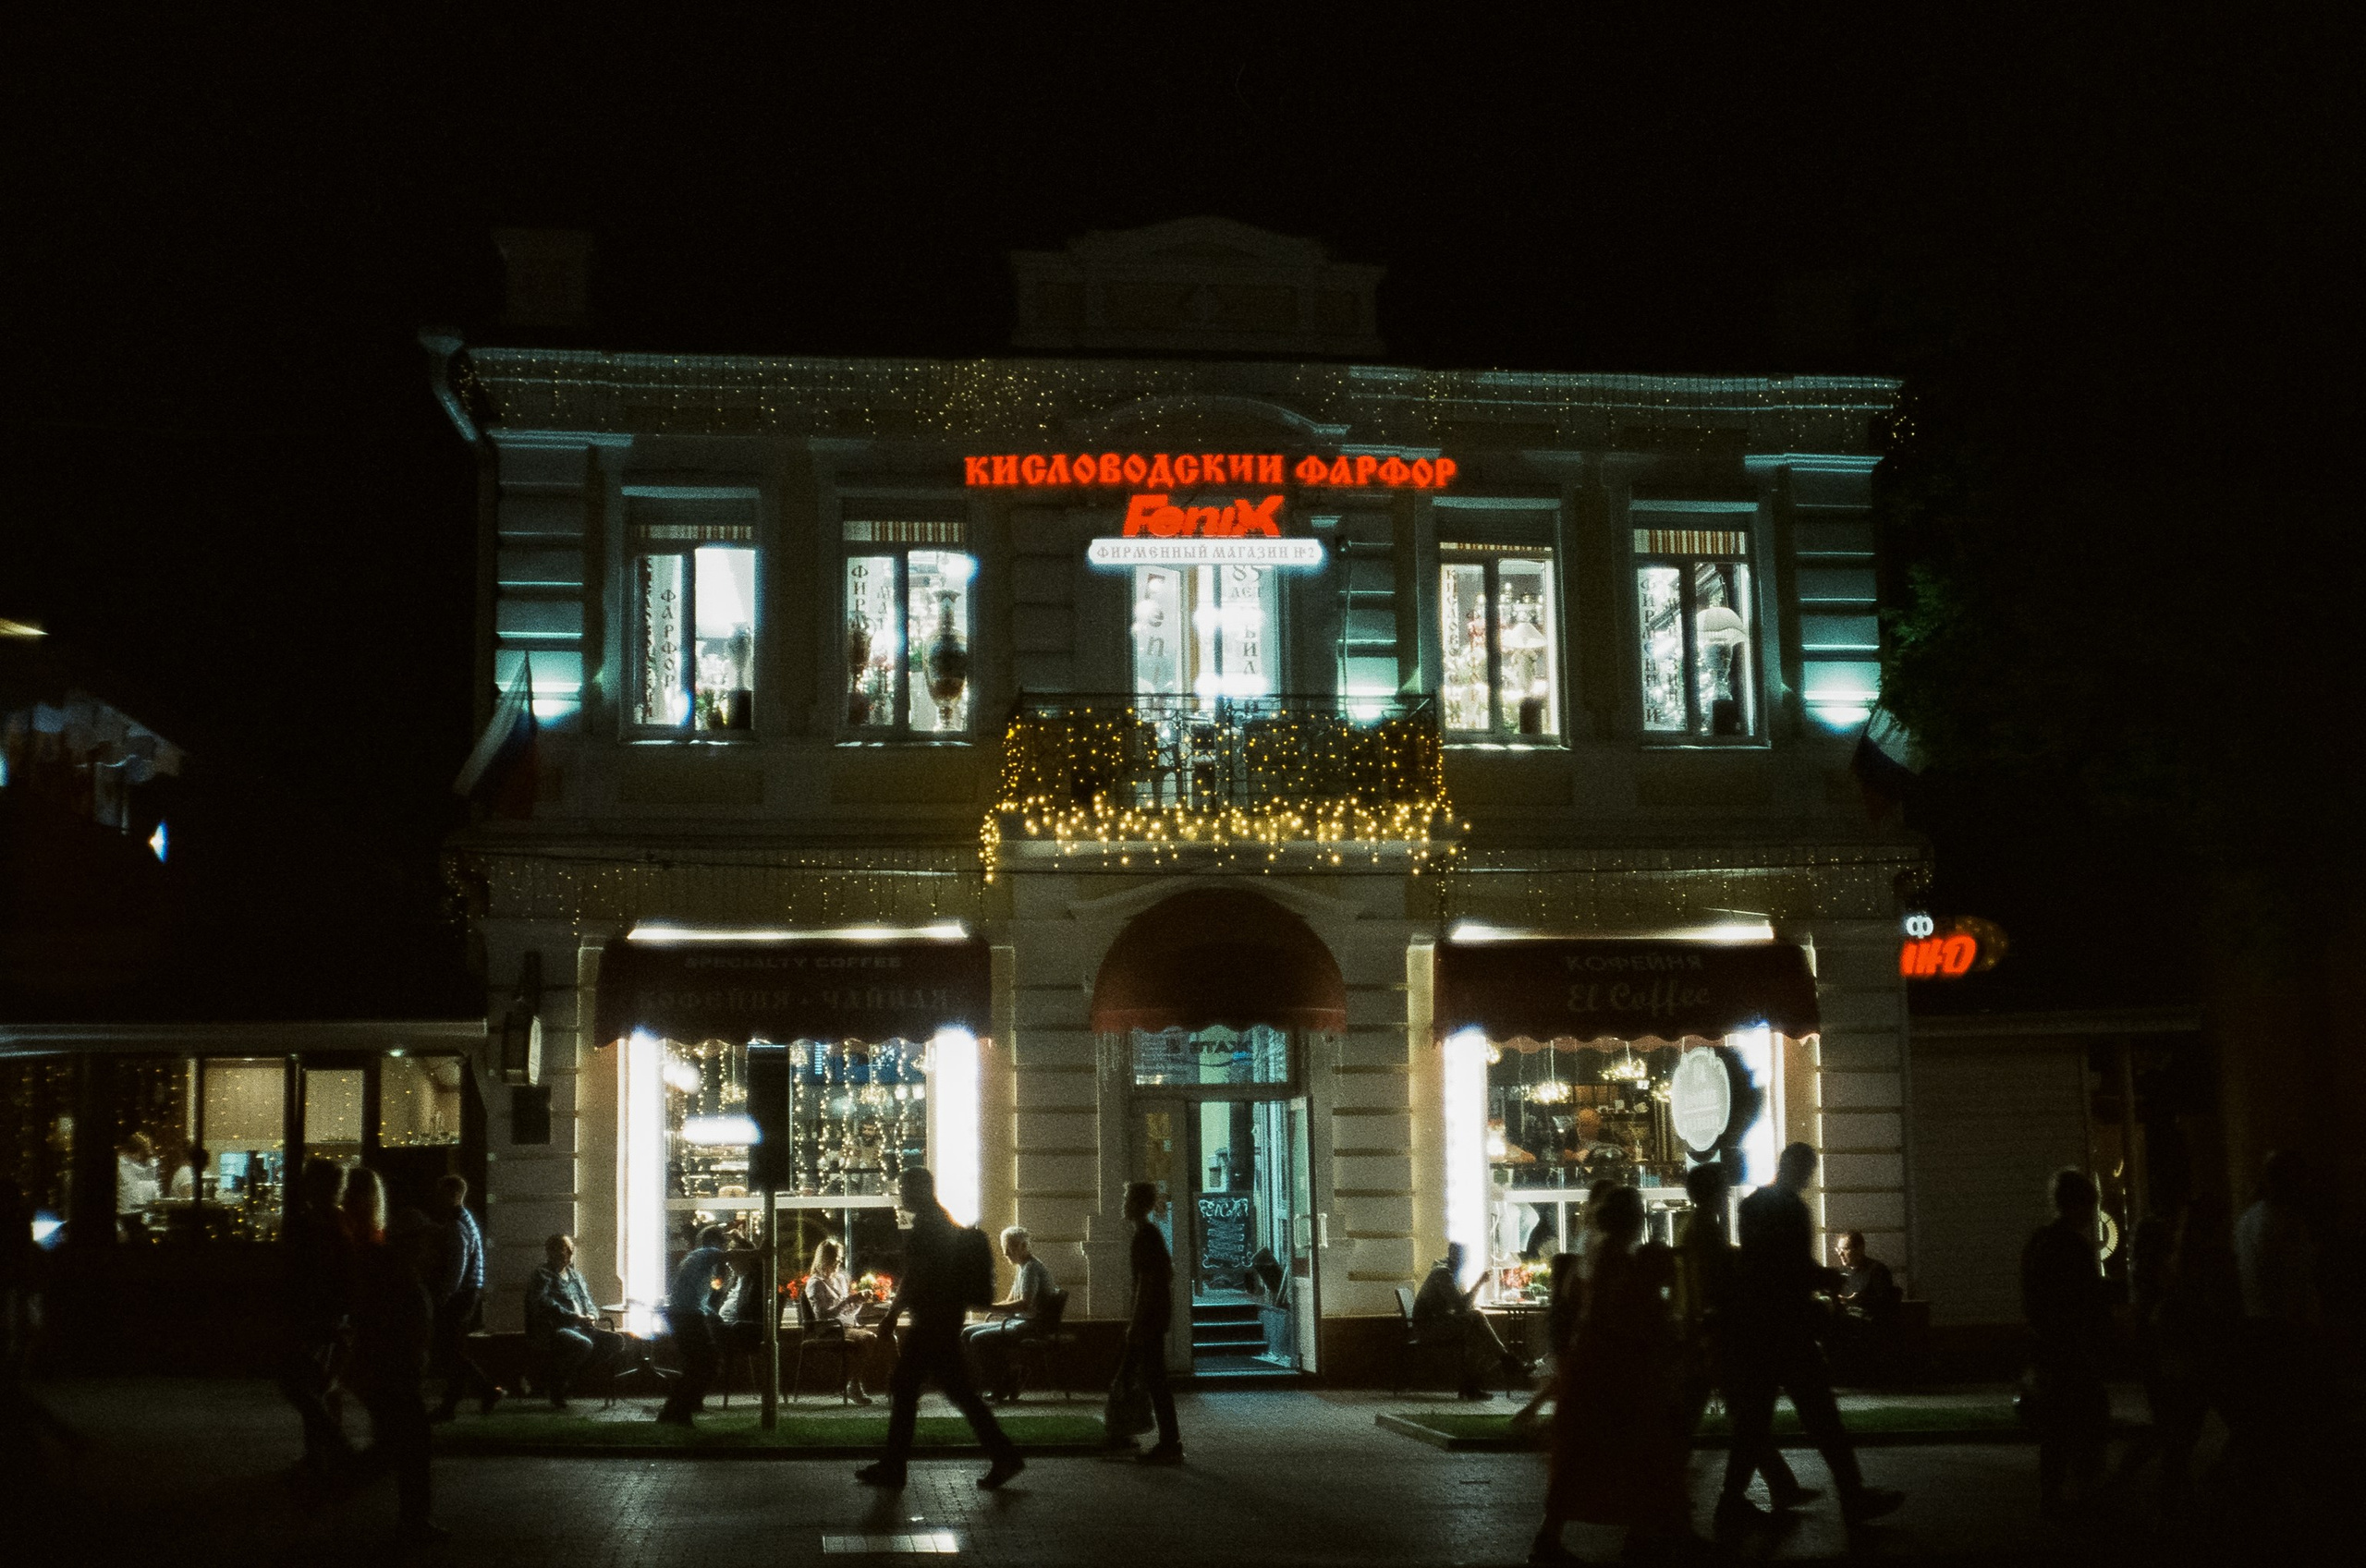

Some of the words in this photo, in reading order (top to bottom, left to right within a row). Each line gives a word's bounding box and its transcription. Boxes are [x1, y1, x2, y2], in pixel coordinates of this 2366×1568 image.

[1295, 456, 1457, 488] ФАРФОР
[1097, 543, 1207, 560] ФИРМЕННЫЙ
[1212, 546, 1289, 561] МАГАЗИН
[660, 589, 677, 687] ФАРФОР
[684, 955, 809, 971] SPECIALTY
[814, 955, 902, 972] COFFEE
[1564, 952, 1703, 972] КОФЕЙНЯ
[1566, 982, 1602, 1014] El
[1609, 979, 1711, 1019] Coffee
